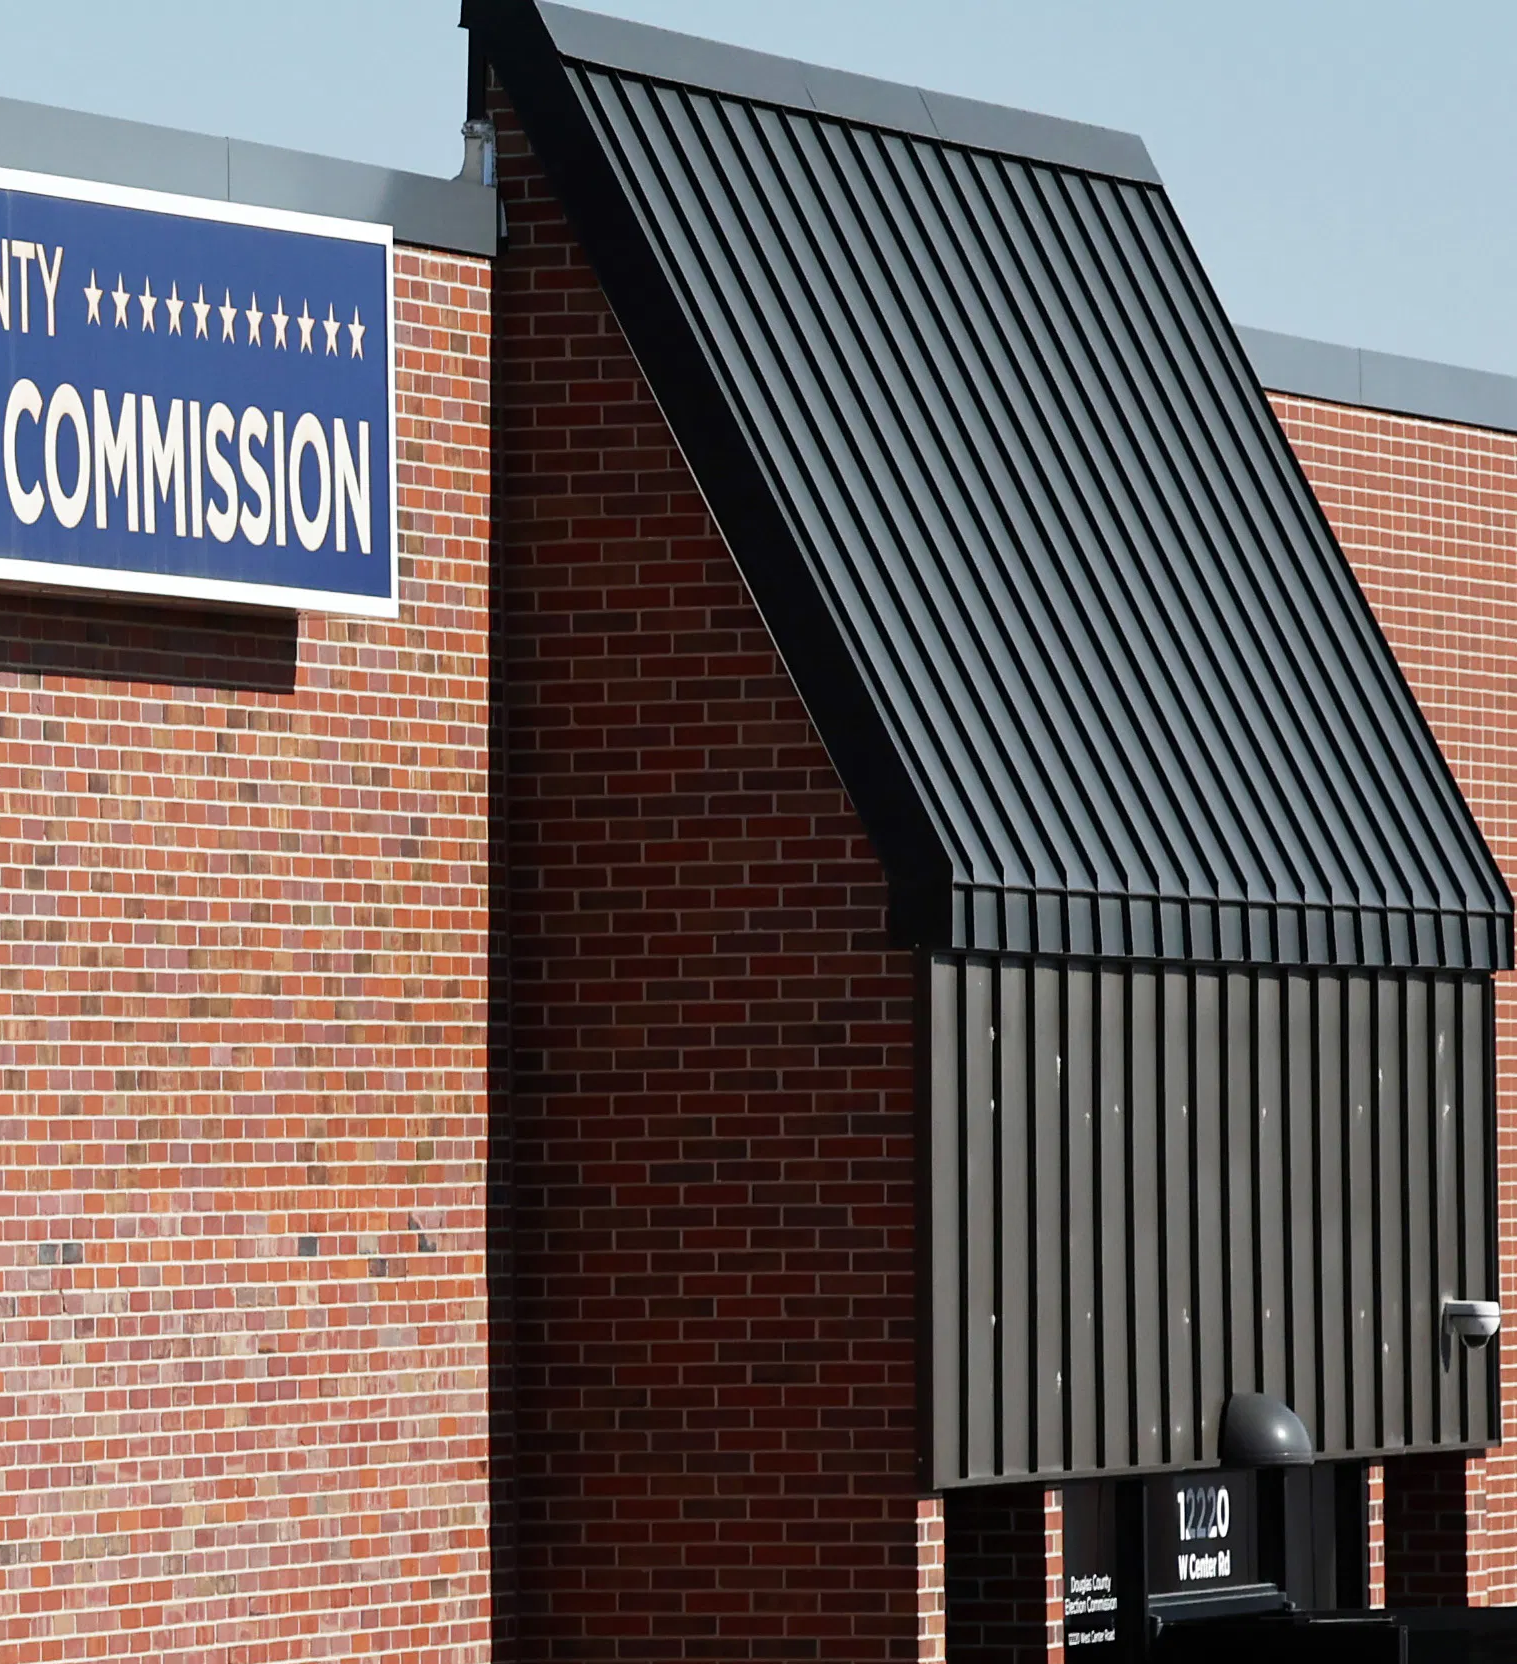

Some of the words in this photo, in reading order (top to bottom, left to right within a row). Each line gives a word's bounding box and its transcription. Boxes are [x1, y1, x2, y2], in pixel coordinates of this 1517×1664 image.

[3, 378, 372, 555] COMMISSION
[1177, 1485, 1230, 1541] 12220
[1178, 1554, 1188, 1581] W
[1190, 1553, 1217, 1580] Center
[1218, 1549, 1231, 1578] Rd
[1070, 1574, 1092, 1595] Douglas
[1092, 1574, 1111, 1593] County
[1065, 1597, 1086, 1615] Election
[1087, 1594, 1117, 1613] Commission
